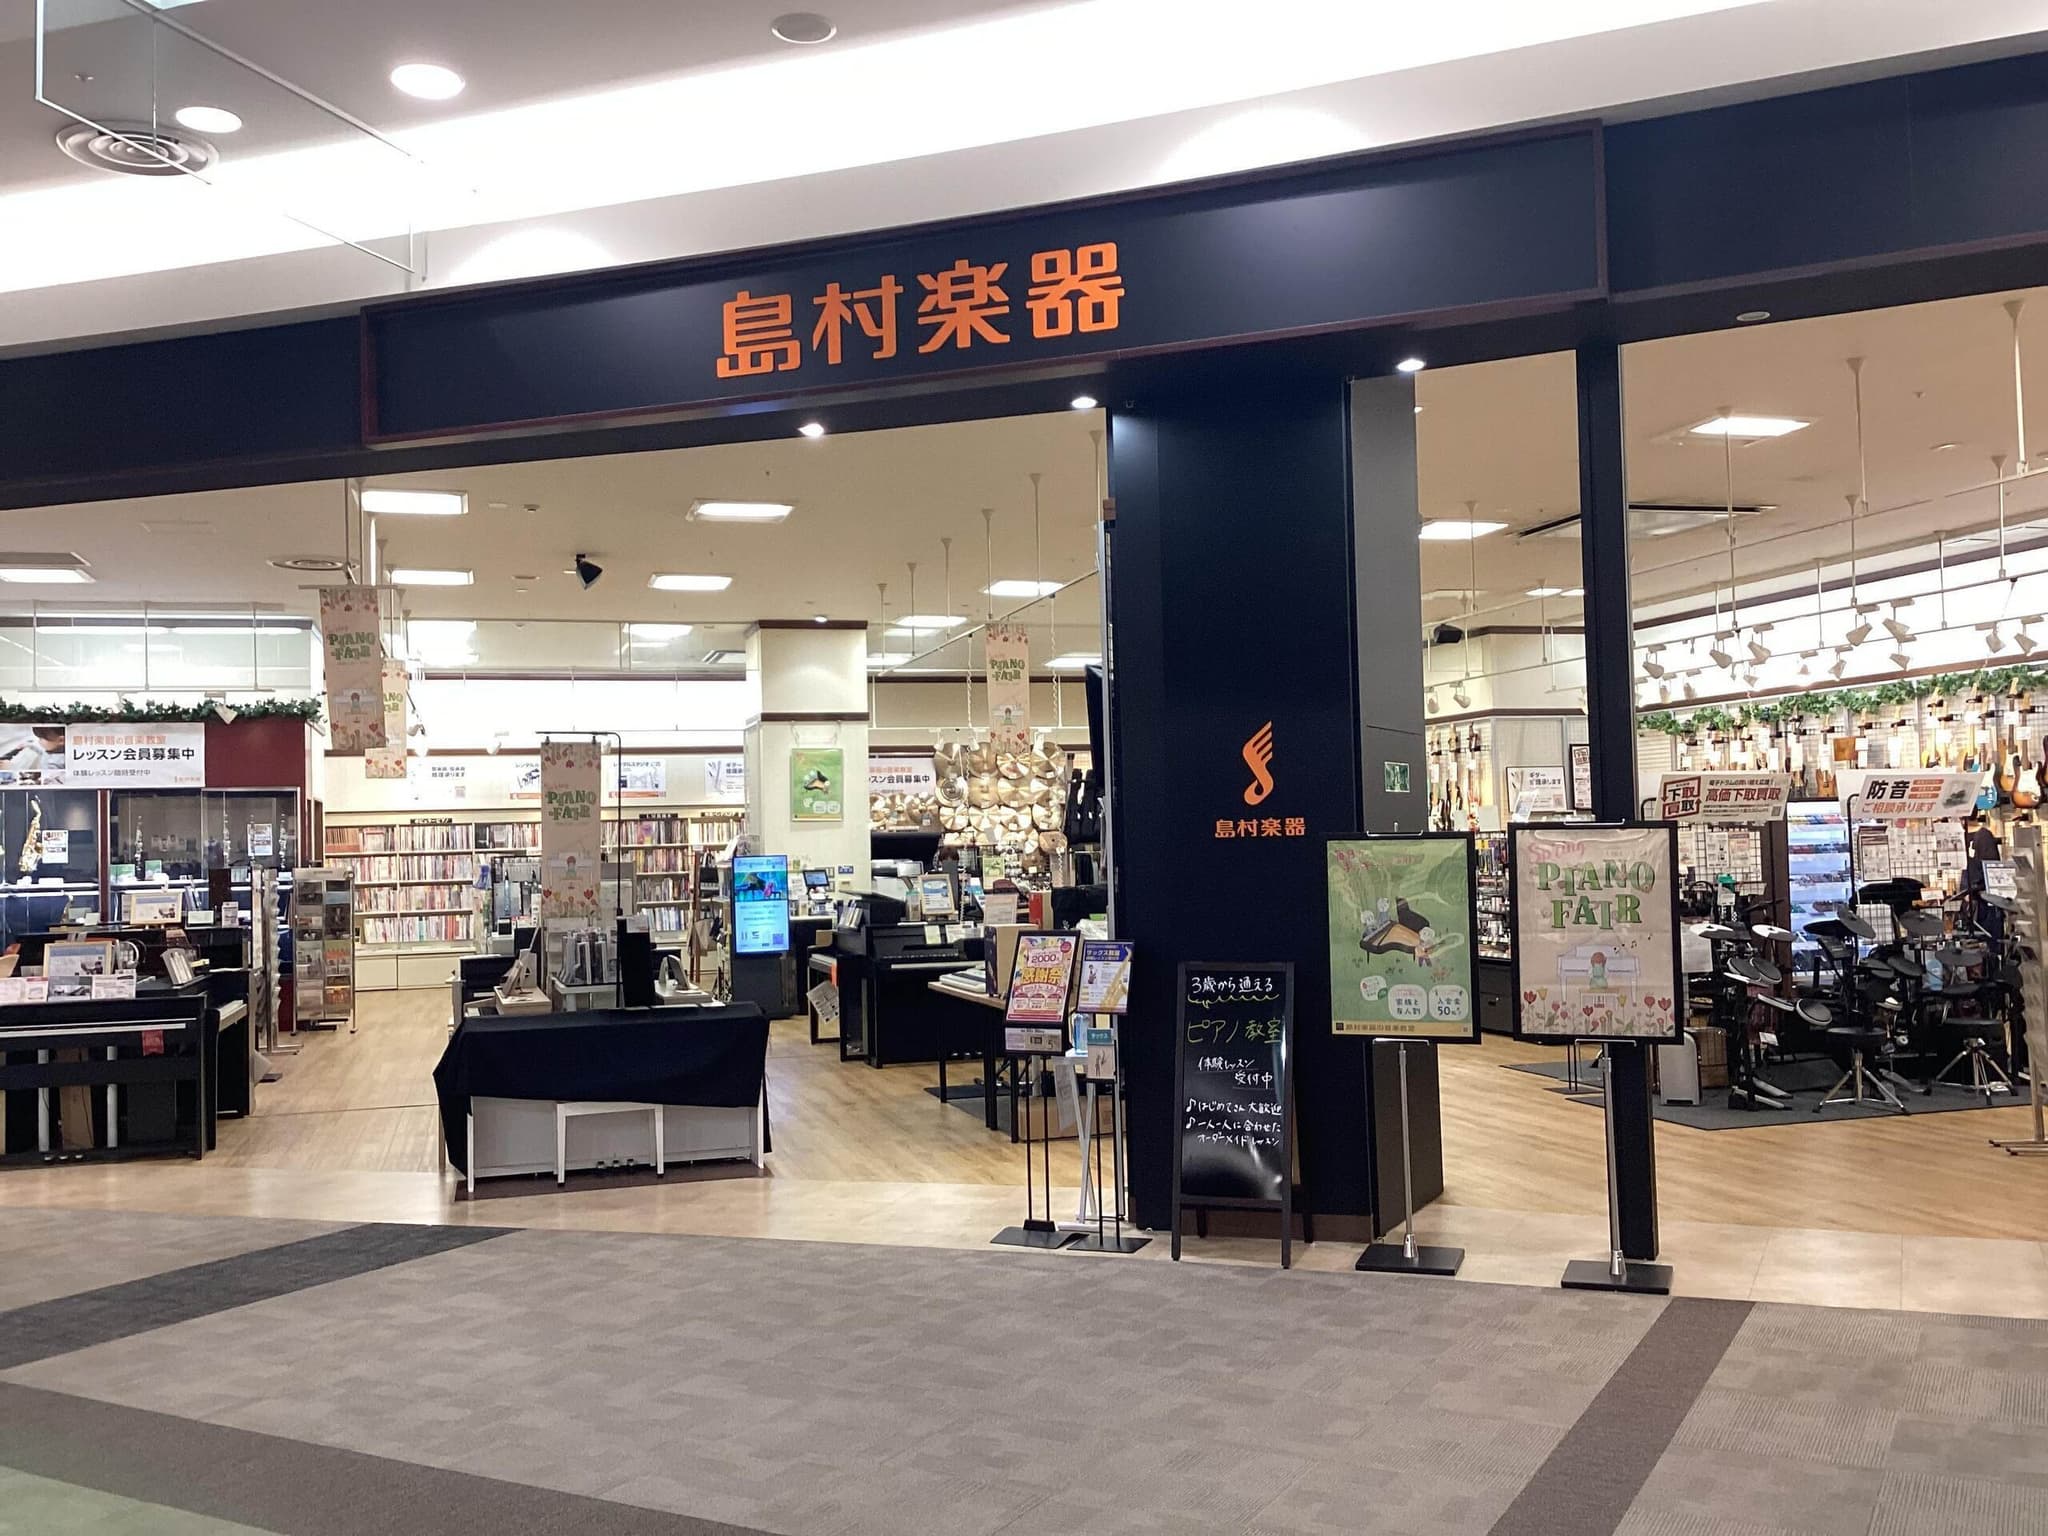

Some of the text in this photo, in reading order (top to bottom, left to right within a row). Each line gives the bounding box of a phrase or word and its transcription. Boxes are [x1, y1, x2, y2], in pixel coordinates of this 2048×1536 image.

[716, 241, 1126, 379] 島村楽器
[327, 631, 376, 647] PIANO
[333, 645, 371, 660] FAIR
[73, 747, 195, 761] レッスン会員募集中
[547, 789, 596, 805] PIANO
[1668, 786, 1695, 801] 下取
[1705, 787, 1782, 802] 高価下取買取
[1866, 779, 1910, 800] 防音
[551, 804, 591, 820] FAIR
[1862, 801, 1937, 814] ご相談承ります
[1214, 817, 1307, 838] 島村楽器
[1536, 858, 1656, 897] PIANO
[1550, 893, 1642, 930] FAIR
[1191, 976, 1273, 993] 3歳から通える
[1187, 1016, 1284, 1044] ピアノ教室
[1235, 1070, 1273, 1090] 受付中
